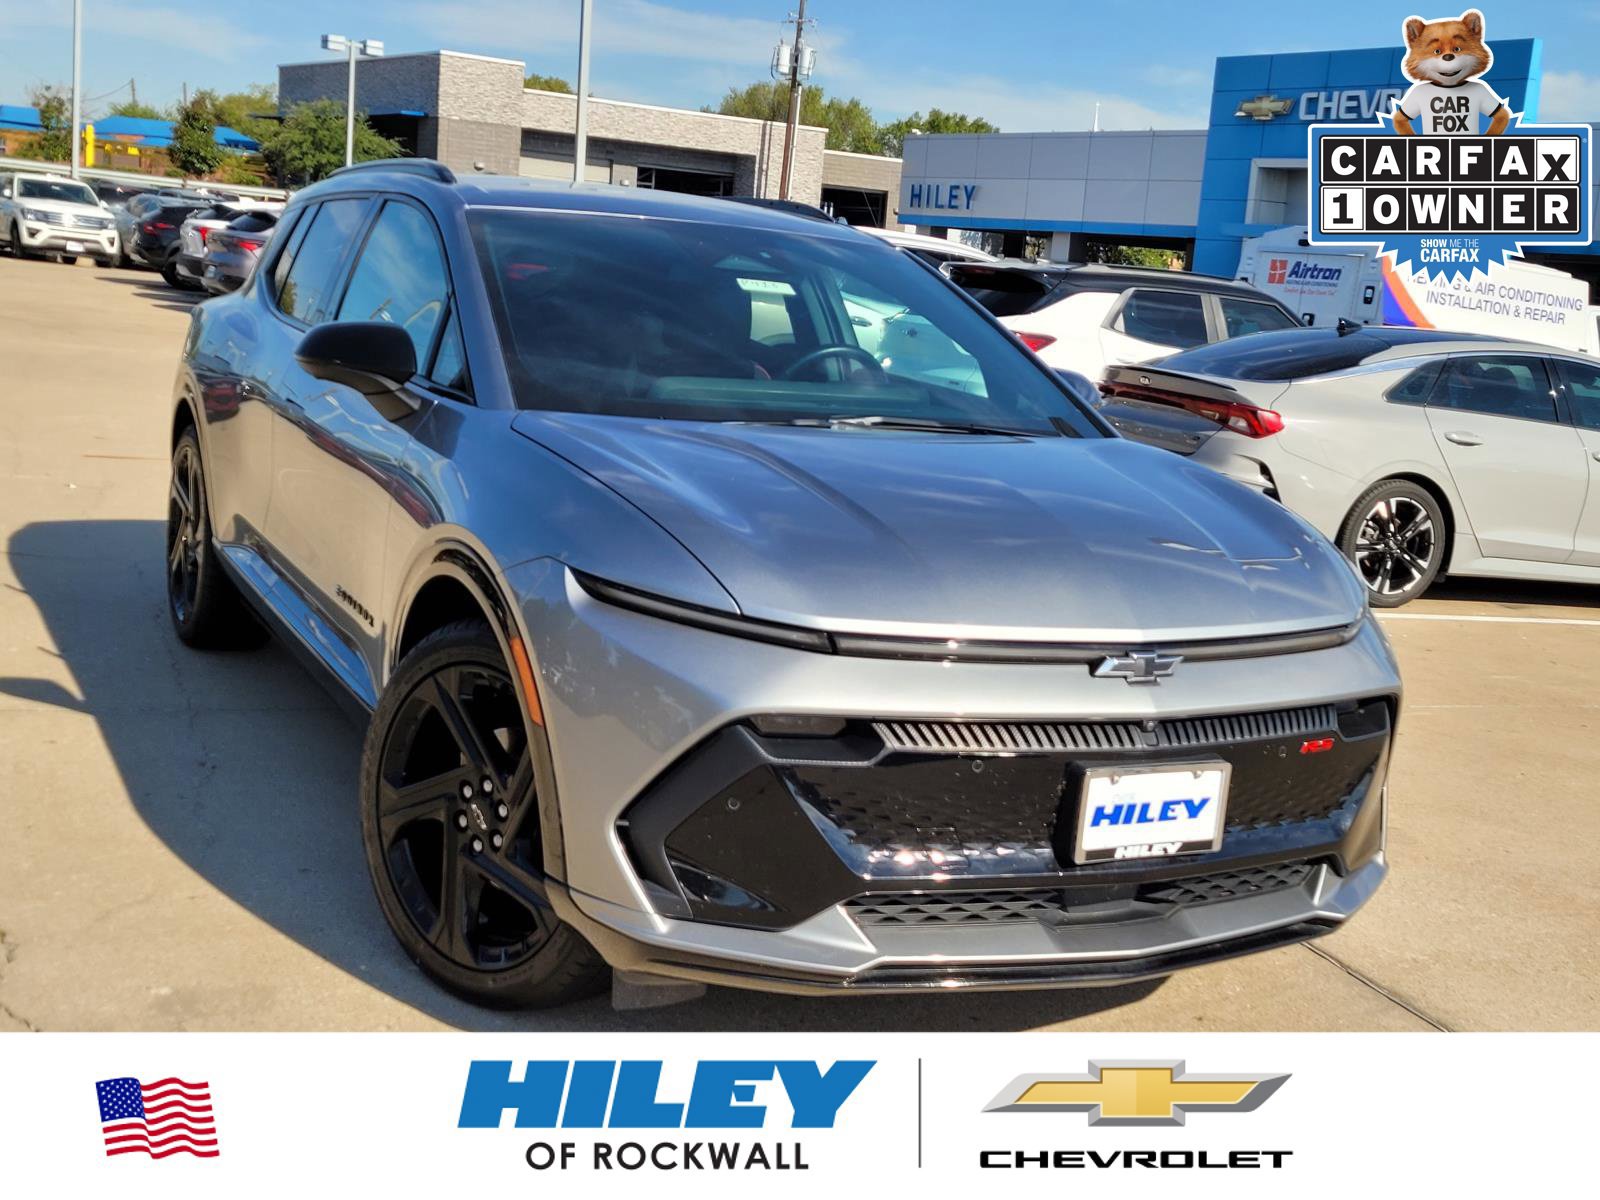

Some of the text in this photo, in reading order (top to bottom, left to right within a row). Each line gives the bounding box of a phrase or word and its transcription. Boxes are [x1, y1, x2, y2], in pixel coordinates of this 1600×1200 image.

[1299, 88, 1406, 120] CHEVR
[910, 184, 976, 209] HILEY
[1426, 290, 1566, 325] INSTALLATION & REPAIR
[1475, 281, 1496, 297] AIR
[1498, 285, 1584, 312] CONDITIONING
[1090, 798, 1210, 828] HILEY
[1114, 841, 1184, 860] HILEY
